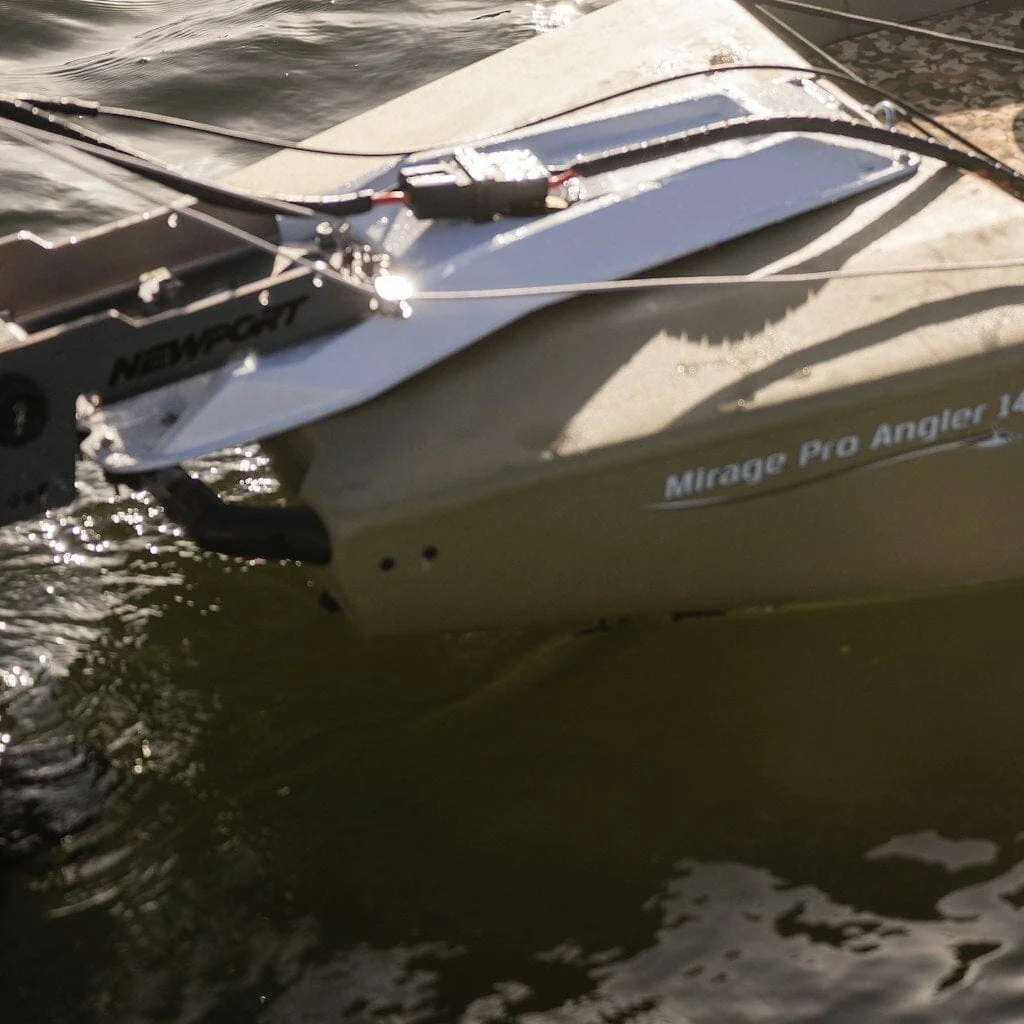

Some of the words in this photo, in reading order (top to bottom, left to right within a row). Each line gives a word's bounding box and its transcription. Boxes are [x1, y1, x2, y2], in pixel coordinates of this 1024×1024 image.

[110, 296, 310, 386] NEWPORT
[663, 449, 788, 500] Mirage
[799, 433, 859, 467] Pro
[869, 402, 991, 450] Angler
